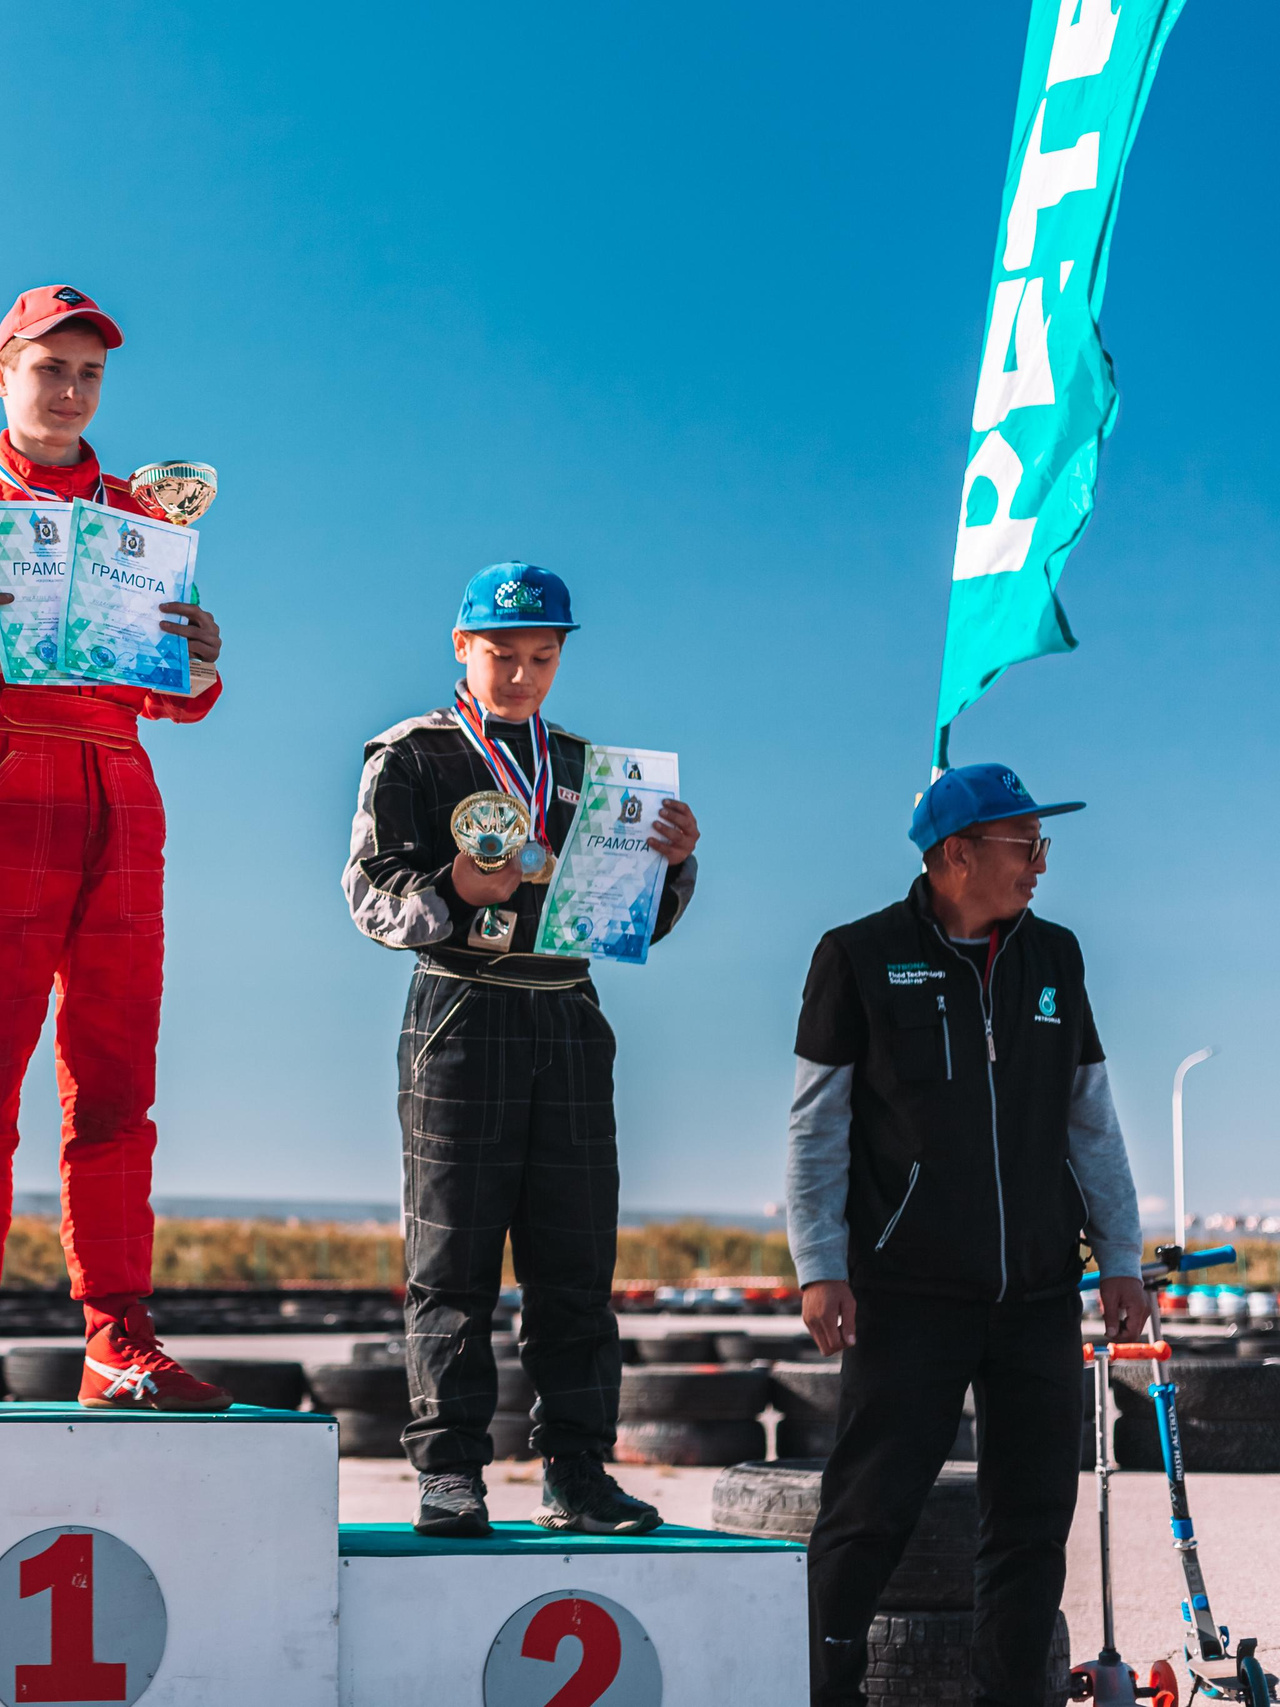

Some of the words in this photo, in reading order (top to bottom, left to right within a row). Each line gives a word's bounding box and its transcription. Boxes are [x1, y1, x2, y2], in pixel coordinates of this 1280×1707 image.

[91, 562, 166, 595] ГРАМОТА
[586, 835, 651, 853] ГРАМОТА
[15, 1533, 126, 1703] 1
[520, 1598, 622, 1707] 2
